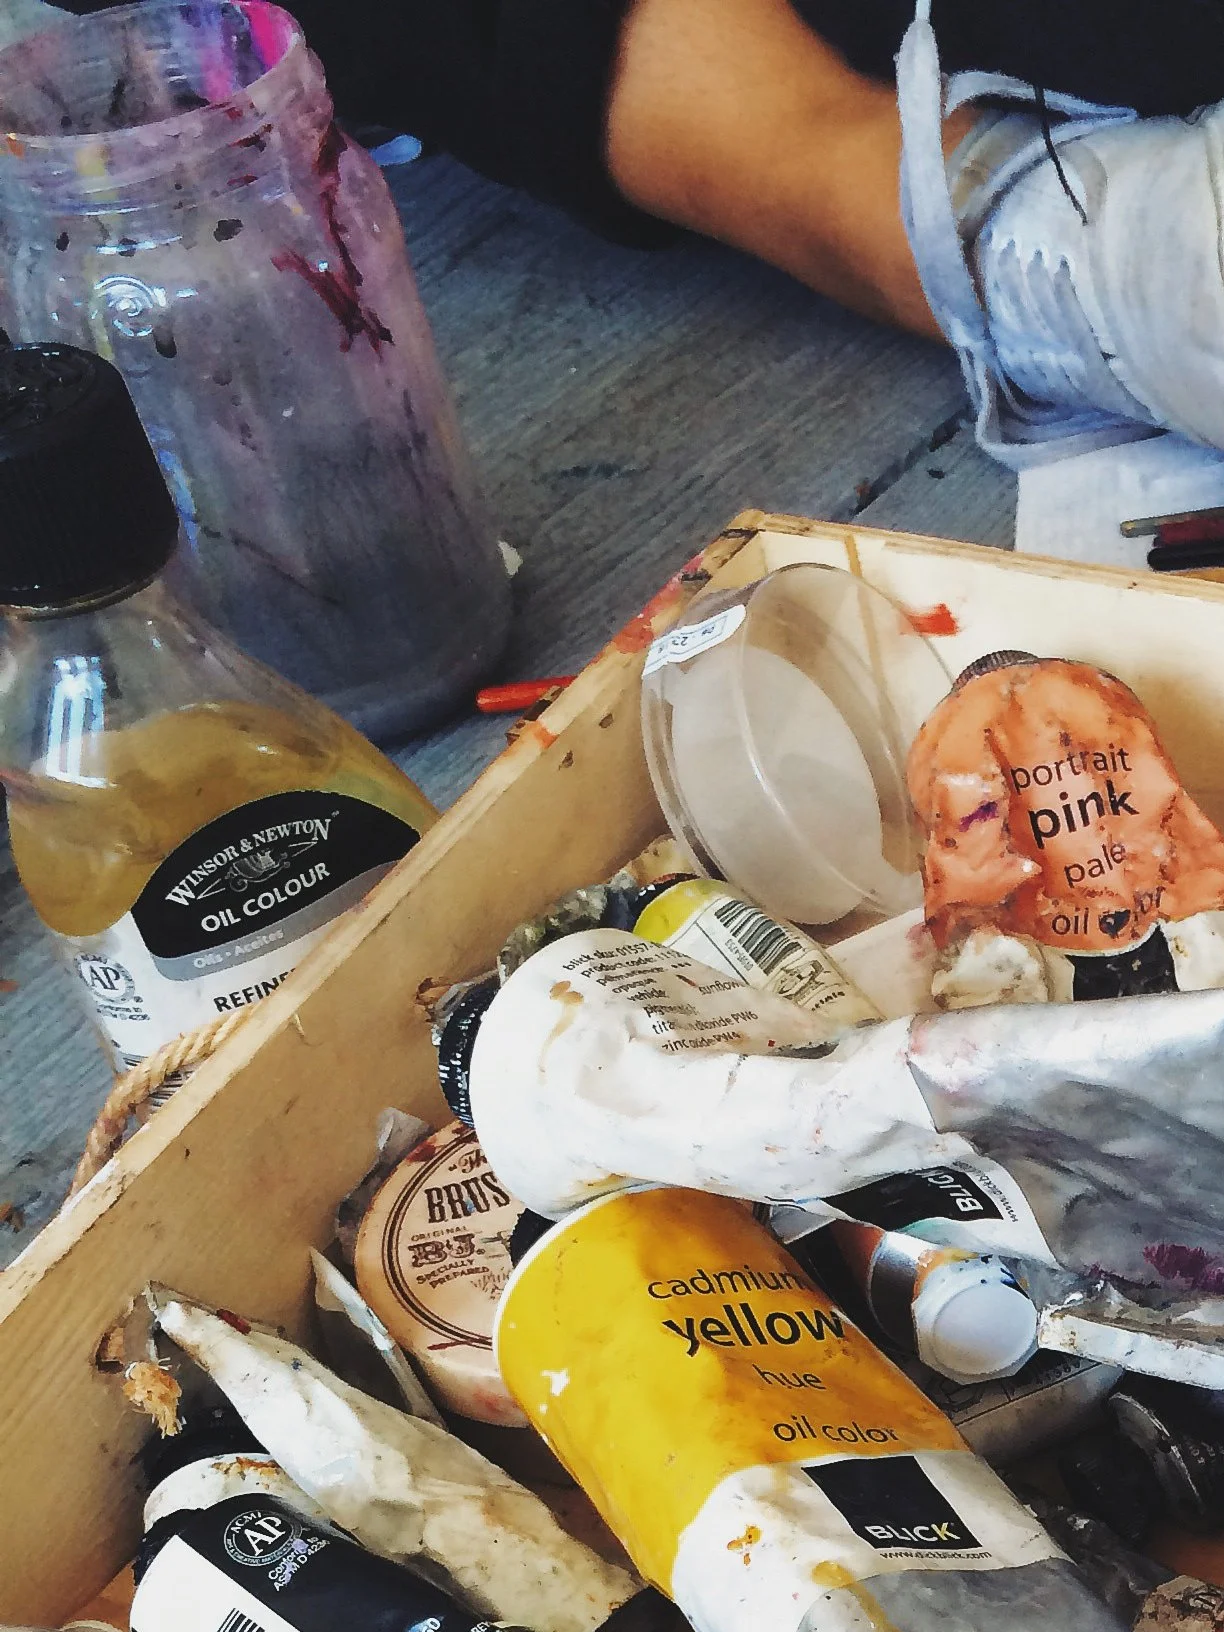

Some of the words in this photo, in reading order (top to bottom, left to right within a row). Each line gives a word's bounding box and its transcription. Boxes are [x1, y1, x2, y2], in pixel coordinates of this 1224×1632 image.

[1010, 743, 1132, 794] portrait
[1028, 779, 1140, 849] pink
[165, 846, 240, 906] WINSOR
[240, 838, 253, 853] &
[252, 818, 331, 848] NEWTON
[1064, 833, 1126, 888] pale
[201, 910, 241, 932] OIL
[242, 862, 331, 917] COLOUR
[1051, 907, 1089, 935] oil
[213, 968, 296, 1013] REFIN
[424, 1171, 510, 1223] BRUS
[416, 1258, 475, 1285] SPECIALLY
[429, 1266, 490, 1289] PREPARED
[661, 1303, 845, 1357] yellow
[752, 1363, 826, 1390] hue
[773, 1414, 817, 1442] oil
[822, 1421, 900, 1443] color
[244, 1516, 286, 1557] AP
[864, 1522, 961, 1542] BLICK
[297, 1554, 308, 1564] D
